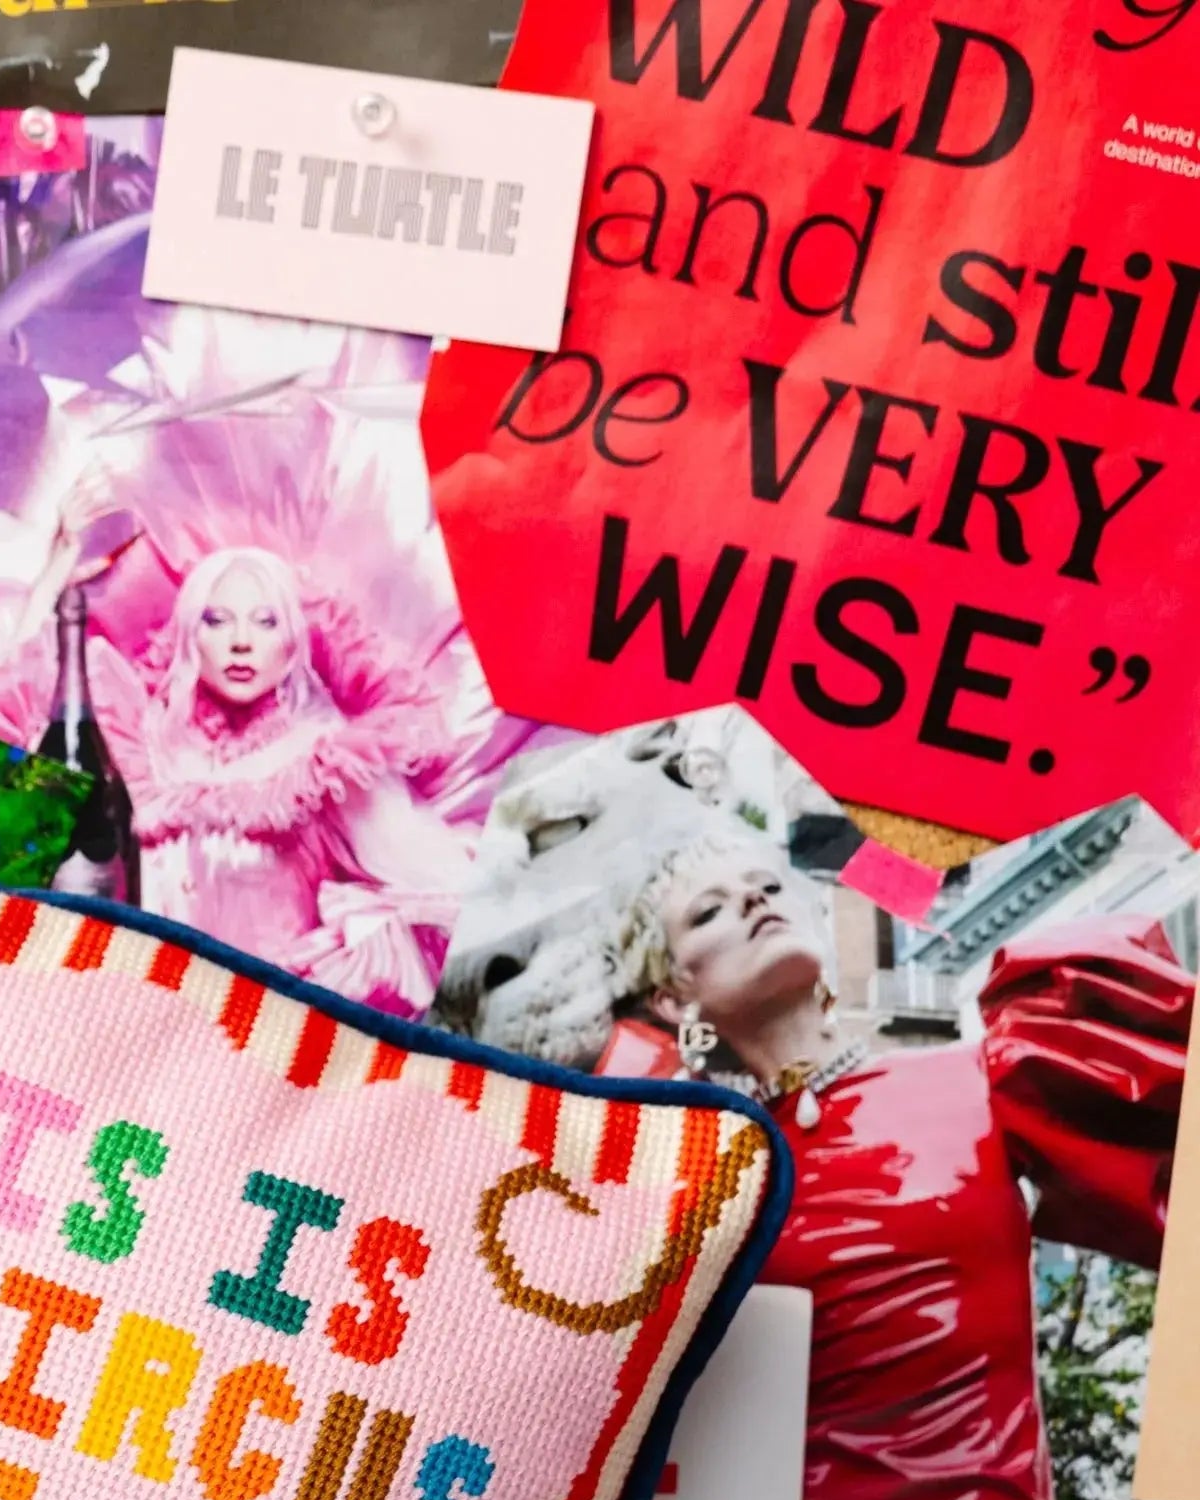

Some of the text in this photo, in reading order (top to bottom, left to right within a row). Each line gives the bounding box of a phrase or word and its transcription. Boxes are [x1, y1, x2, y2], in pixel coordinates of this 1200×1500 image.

[604, 0, 1035, 168] WILD
[1122, 113, 1195, 149] A world
[215, 145, 524, 257] LE TURTLE
[586, 163, 1200, 414] and stil
[496, 309, 1166, 586] be VERY
[207, 1169, 431, 1366] IS
